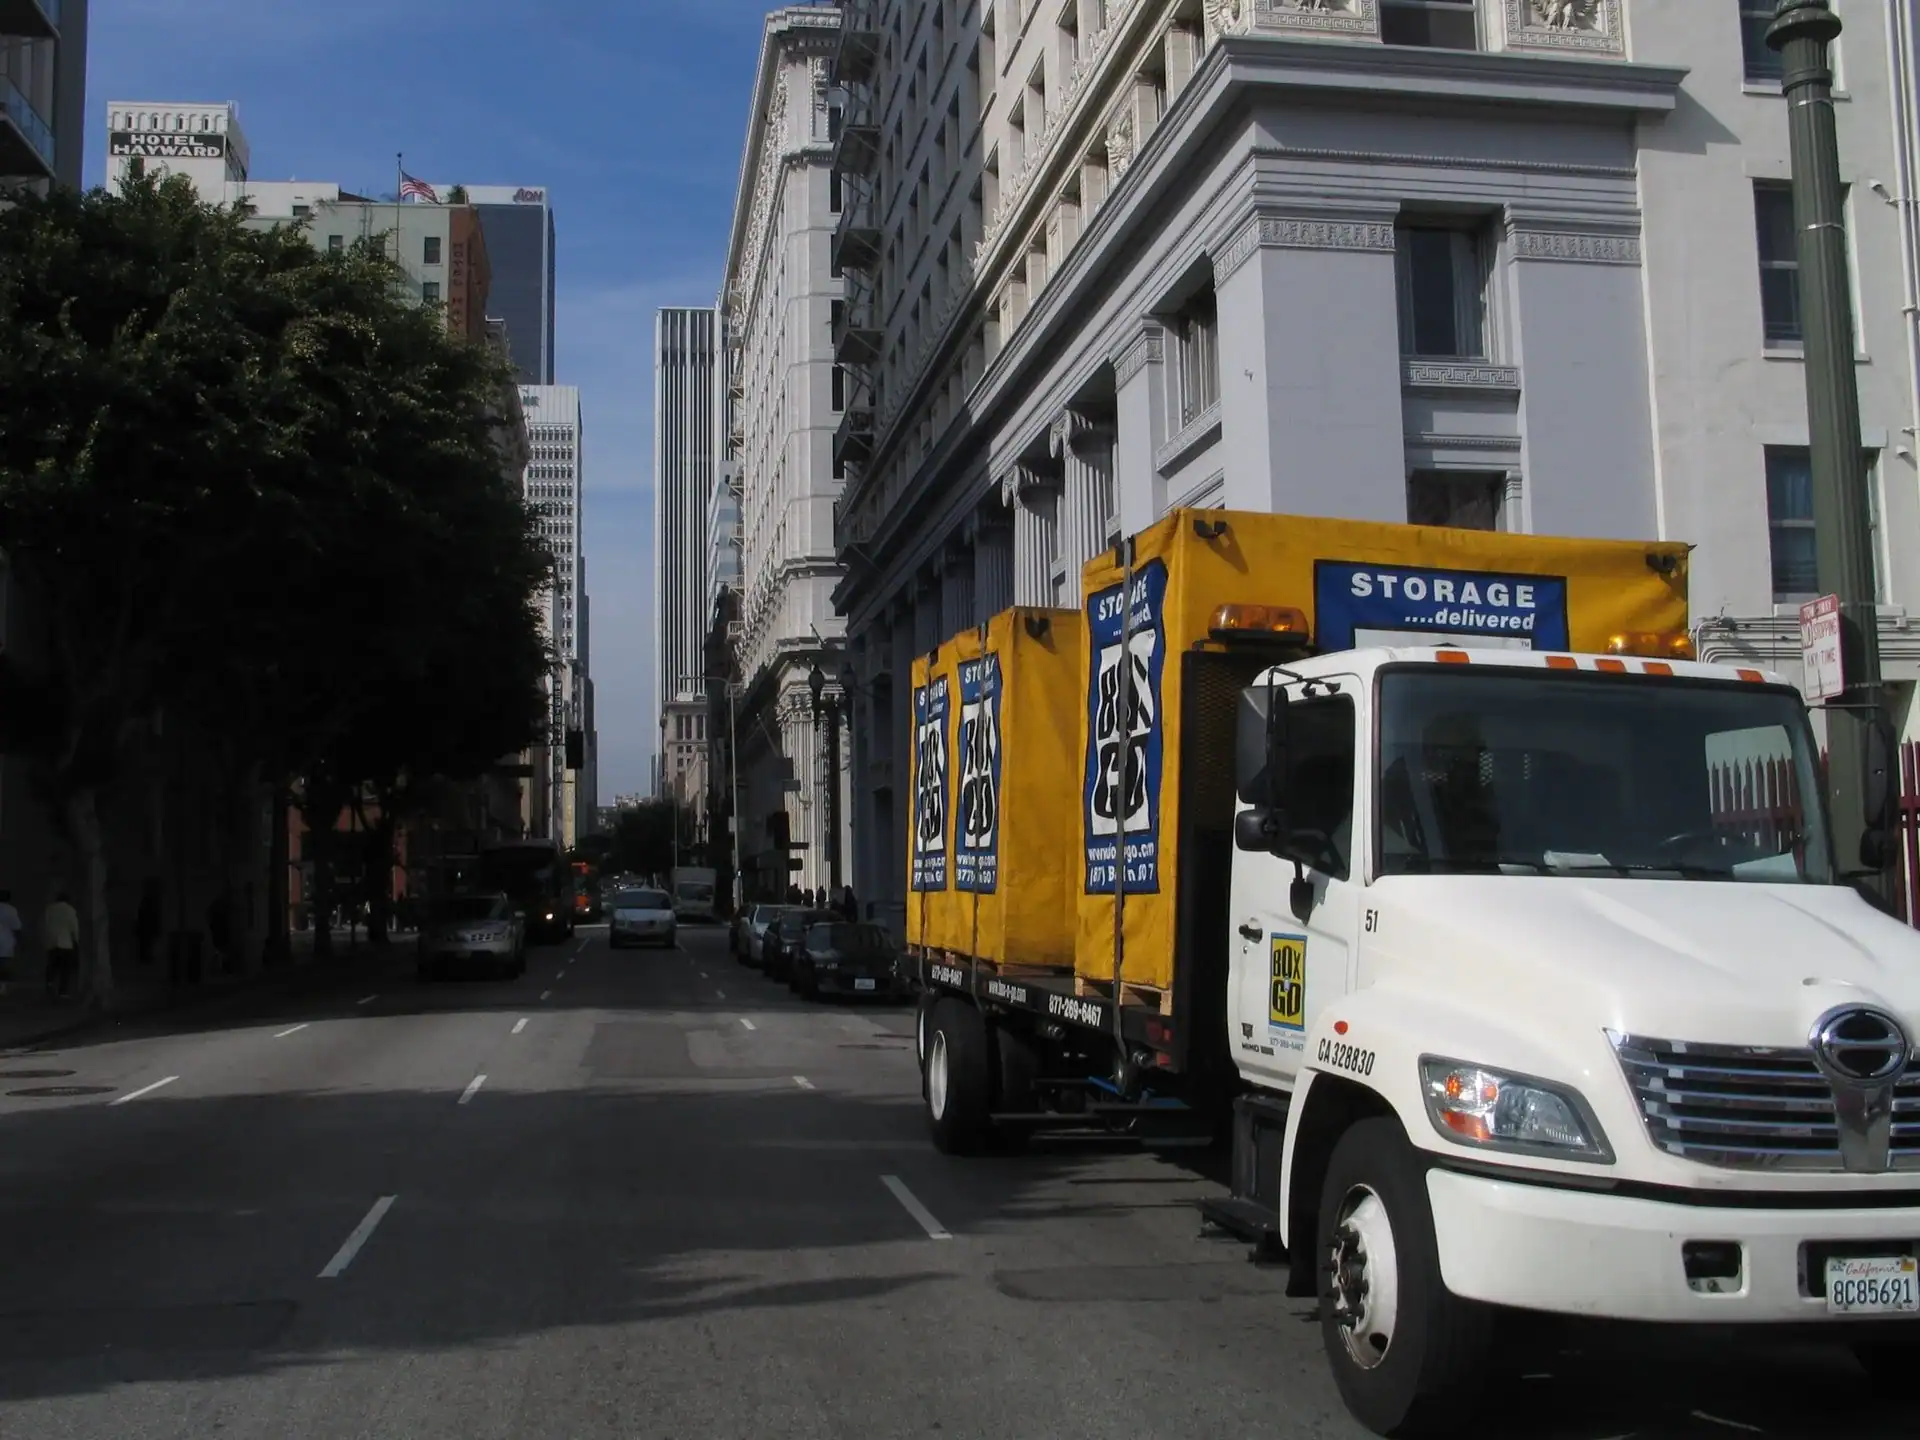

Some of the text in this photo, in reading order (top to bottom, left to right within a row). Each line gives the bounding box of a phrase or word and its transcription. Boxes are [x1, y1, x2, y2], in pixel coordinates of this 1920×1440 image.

[113, 144, 221, 157] HAYWARD
[130, 134, 204, 146] HOTEL
[1351, 572, 1536, 609] STORAGE
[1820, 646, 1836, 666] TIME
[1365, 909, 1378, 933] 51
[1273, 945, 1301, 980] BOX
[1049, 994, 1102, 1027] 877-269-6467
[1272, 979, 1301, 1018] GO
[1845, 1262, 1896, 1277] California
[1833, 1278, 1913, 1305] 8C85691
